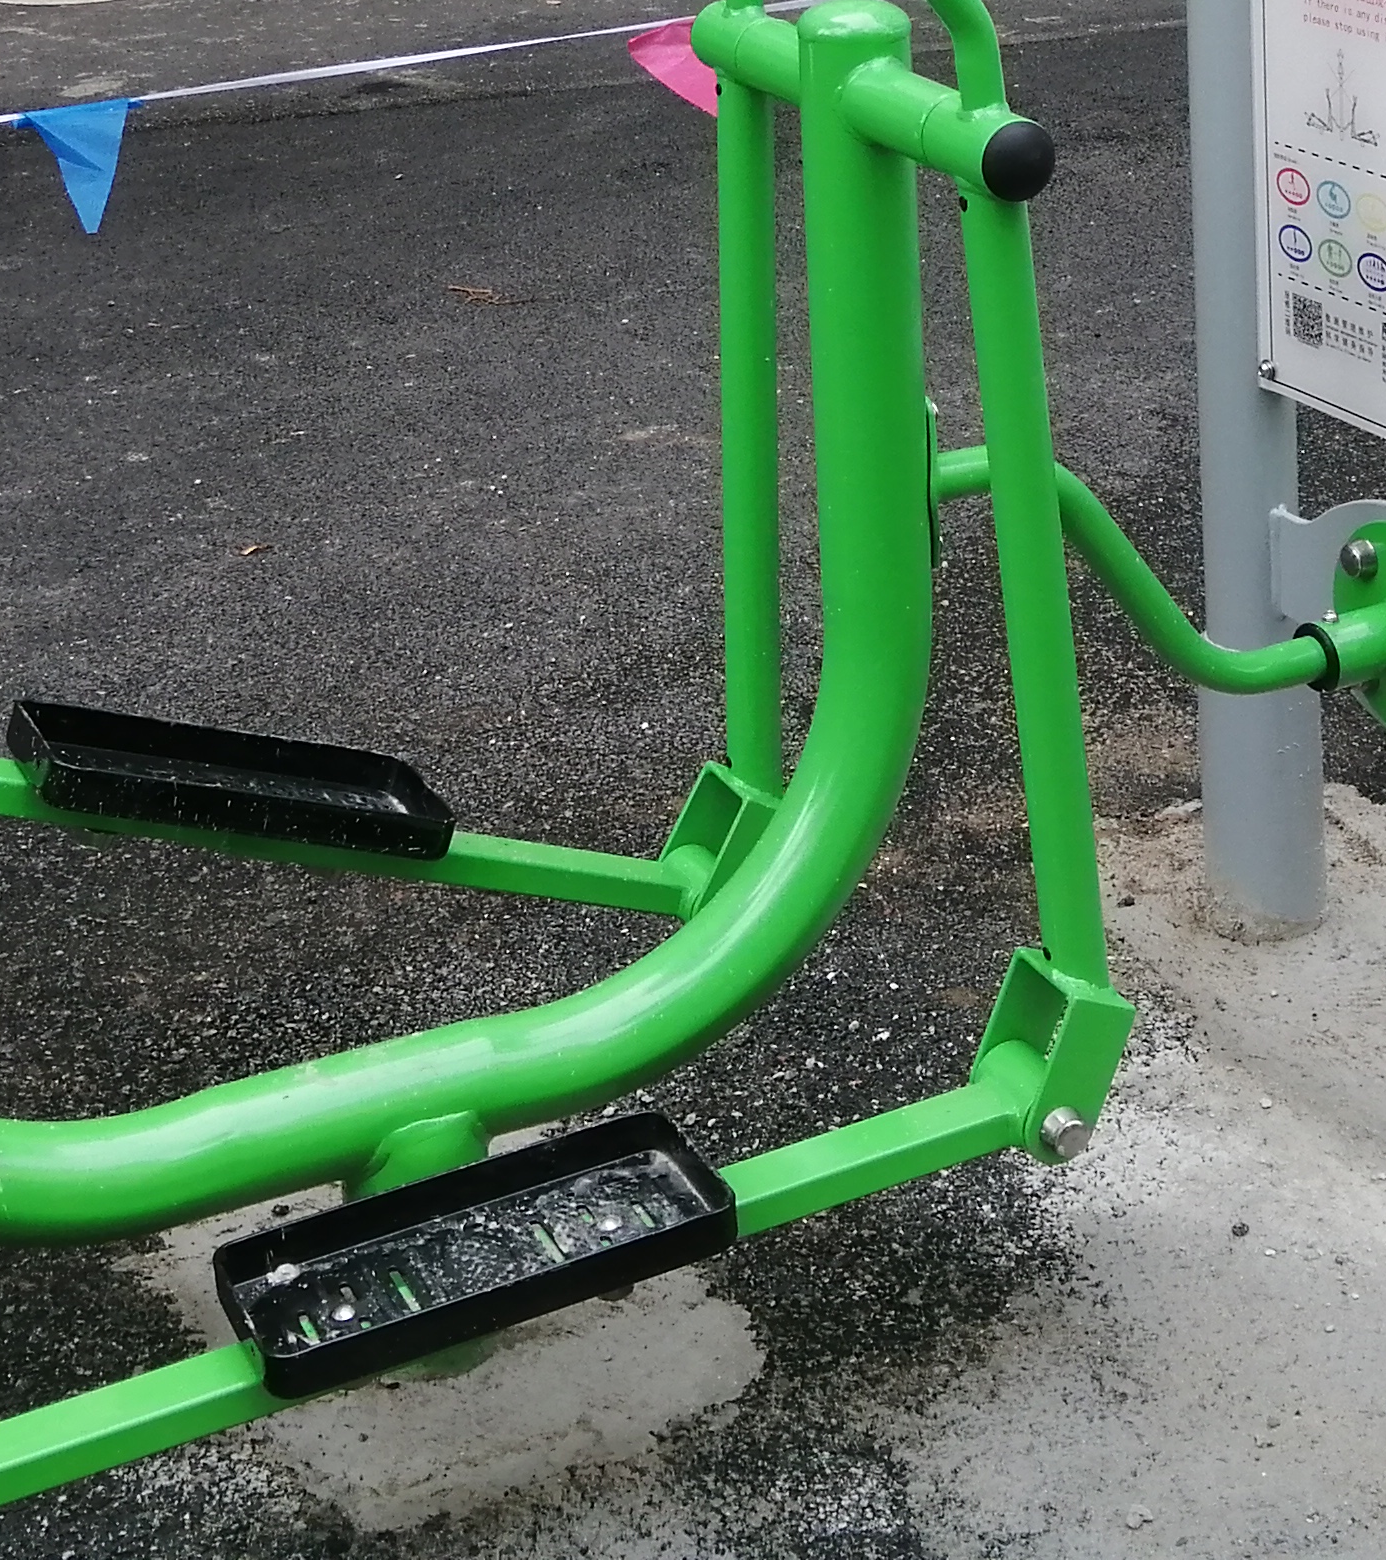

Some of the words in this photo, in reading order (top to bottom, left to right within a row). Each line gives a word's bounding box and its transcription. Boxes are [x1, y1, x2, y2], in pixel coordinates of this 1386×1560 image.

[1344, 6, 1353, 16] is
[1356, 10, 1371, 22] any
[1303, 13, 1330, 28] please
[1335, 21, 1353, 35] stop
[1356, 27, 1380, 42] using
